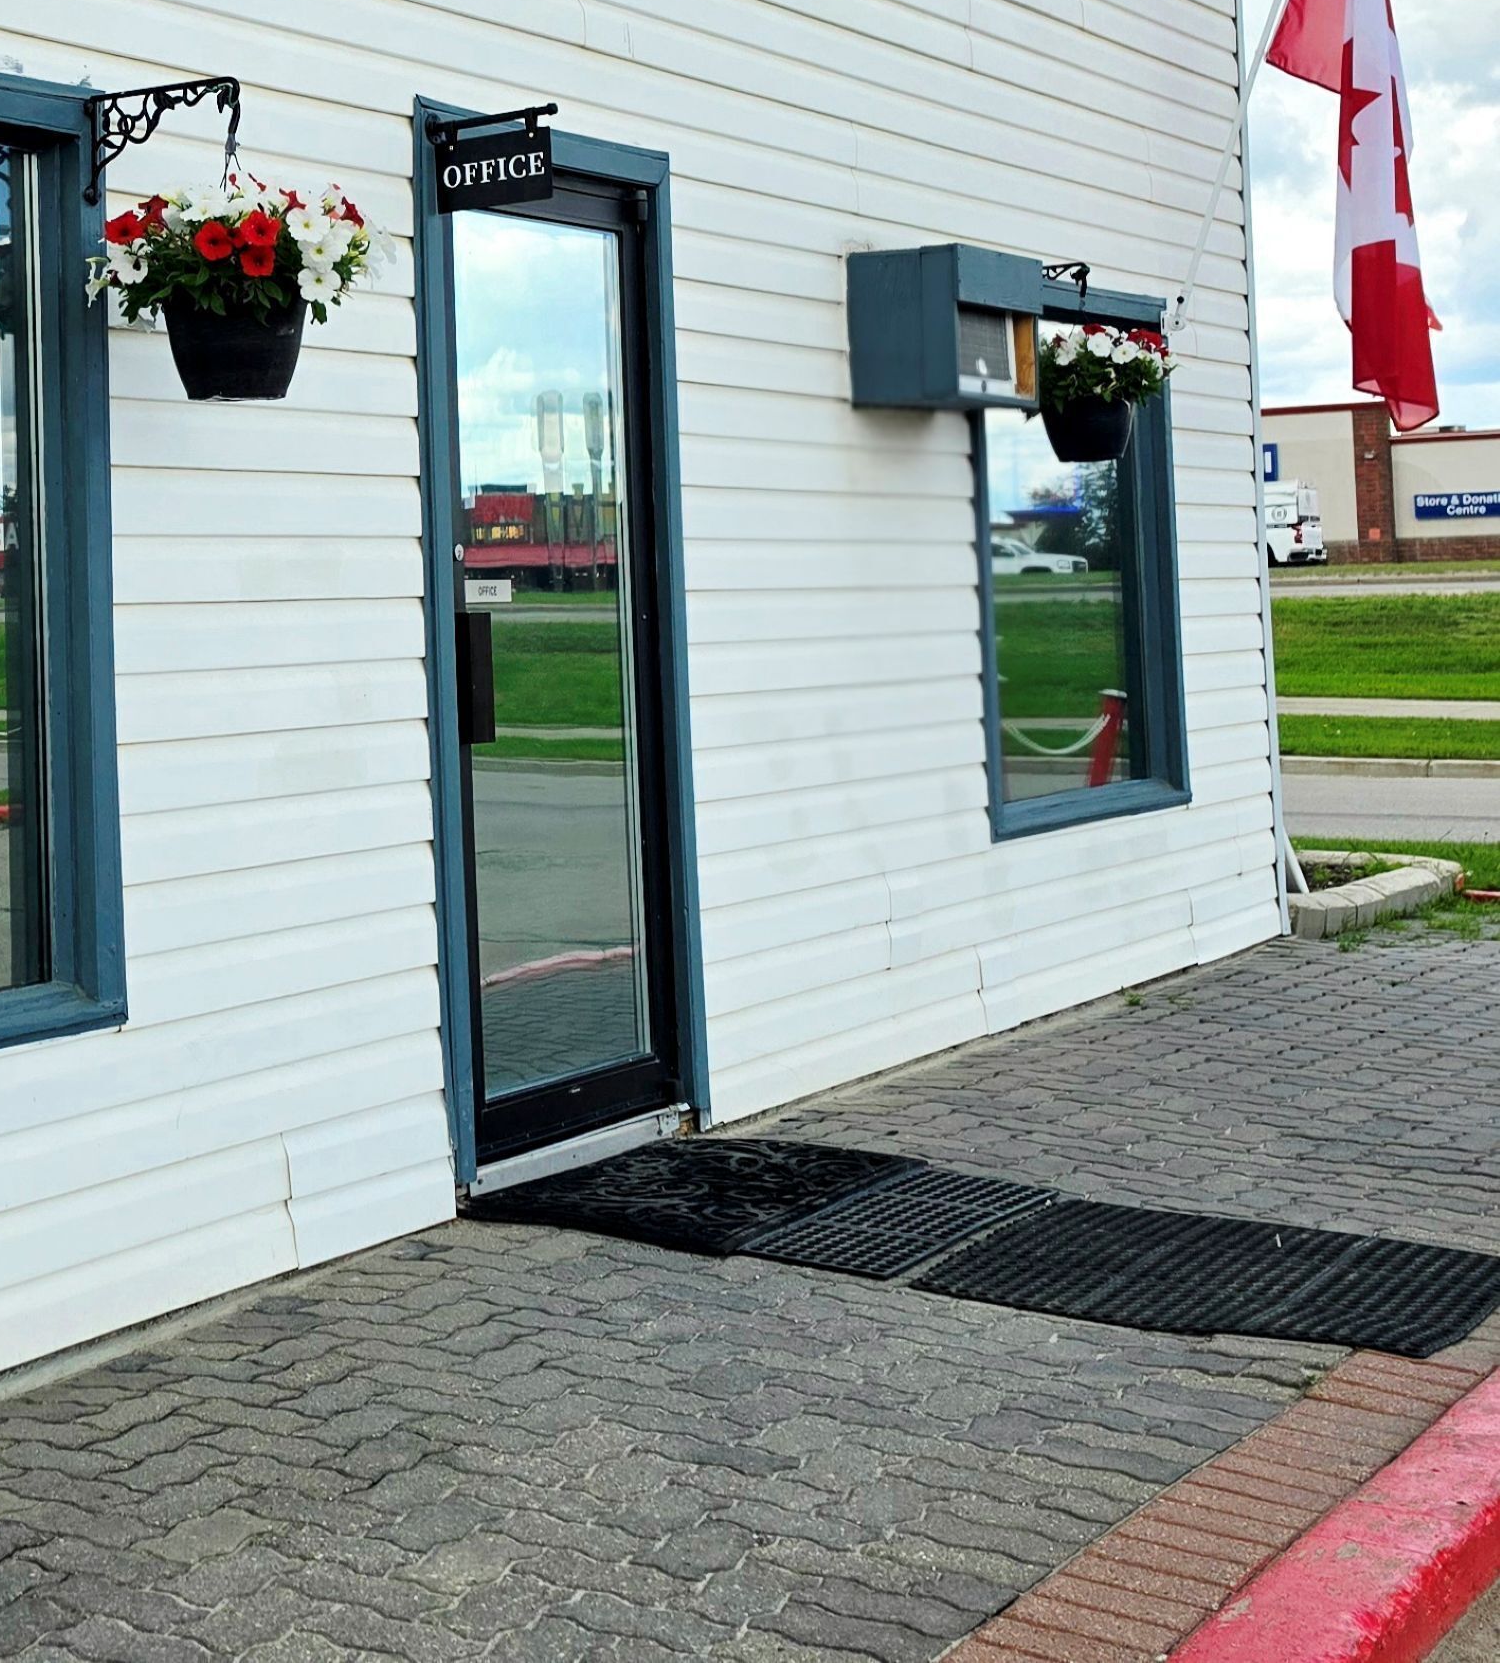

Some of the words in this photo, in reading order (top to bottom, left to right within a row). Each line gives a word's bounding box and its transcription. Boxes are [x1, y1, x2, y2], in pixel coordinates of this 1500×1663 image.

[443, 151, 545, 188] OFFICE
[1416, 495, 1448, 507] Store
[1446, 505, 1487, 516] Centre
[478, 586, 498, 596] OFFICE
